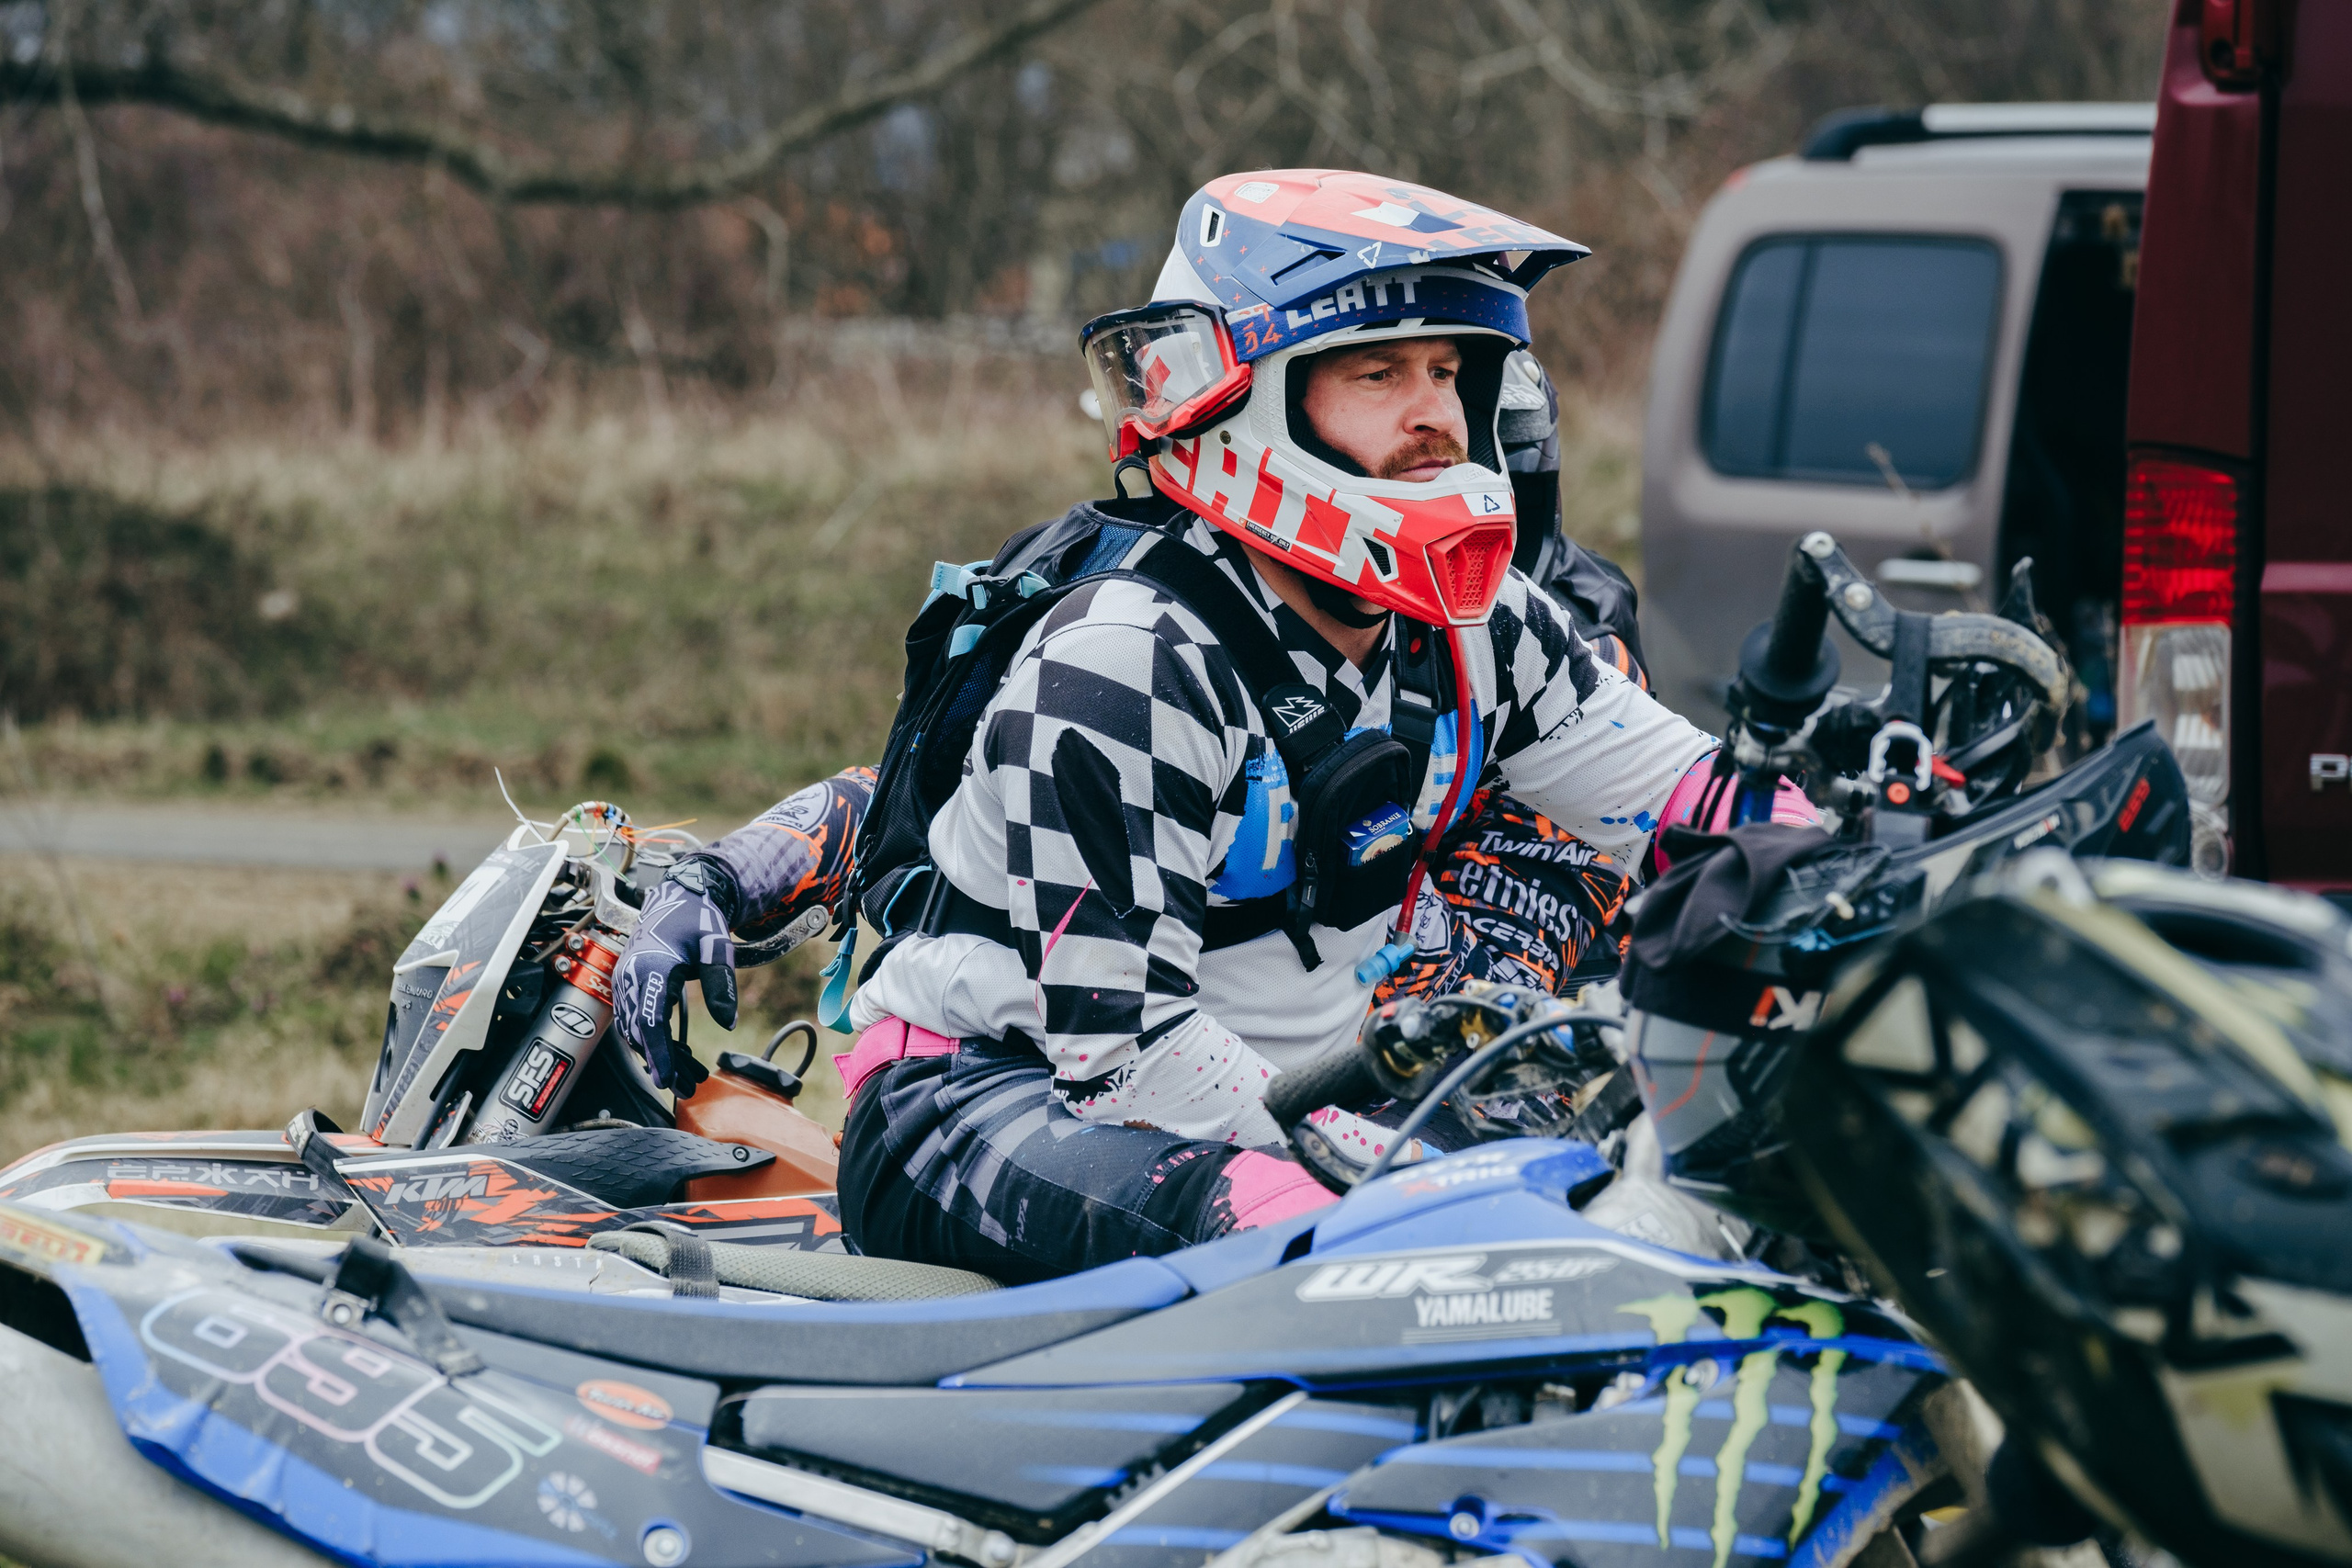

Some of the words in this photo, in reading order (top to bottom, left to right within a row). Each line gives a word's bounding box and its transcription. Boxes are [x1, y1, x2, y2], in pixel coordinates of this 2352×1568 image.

[1286, 275, 1422, 330] LEATT
[2310, 753, 2352, 793] P
[1368, 812, 1402, 833] SOBRANIE
[1478, 829, 1553, 862] Twin
[1554, 842, 1600, 866] Air
[1459, 861, 1578, 942] etnies
[507, 1044, 555, 1110] SFS
[384, 1171, 489, 1205] KTM
[1296, 1253, 1493, 1302] WR
[1415, 1288, 1555, 1327] YAMALUBE
